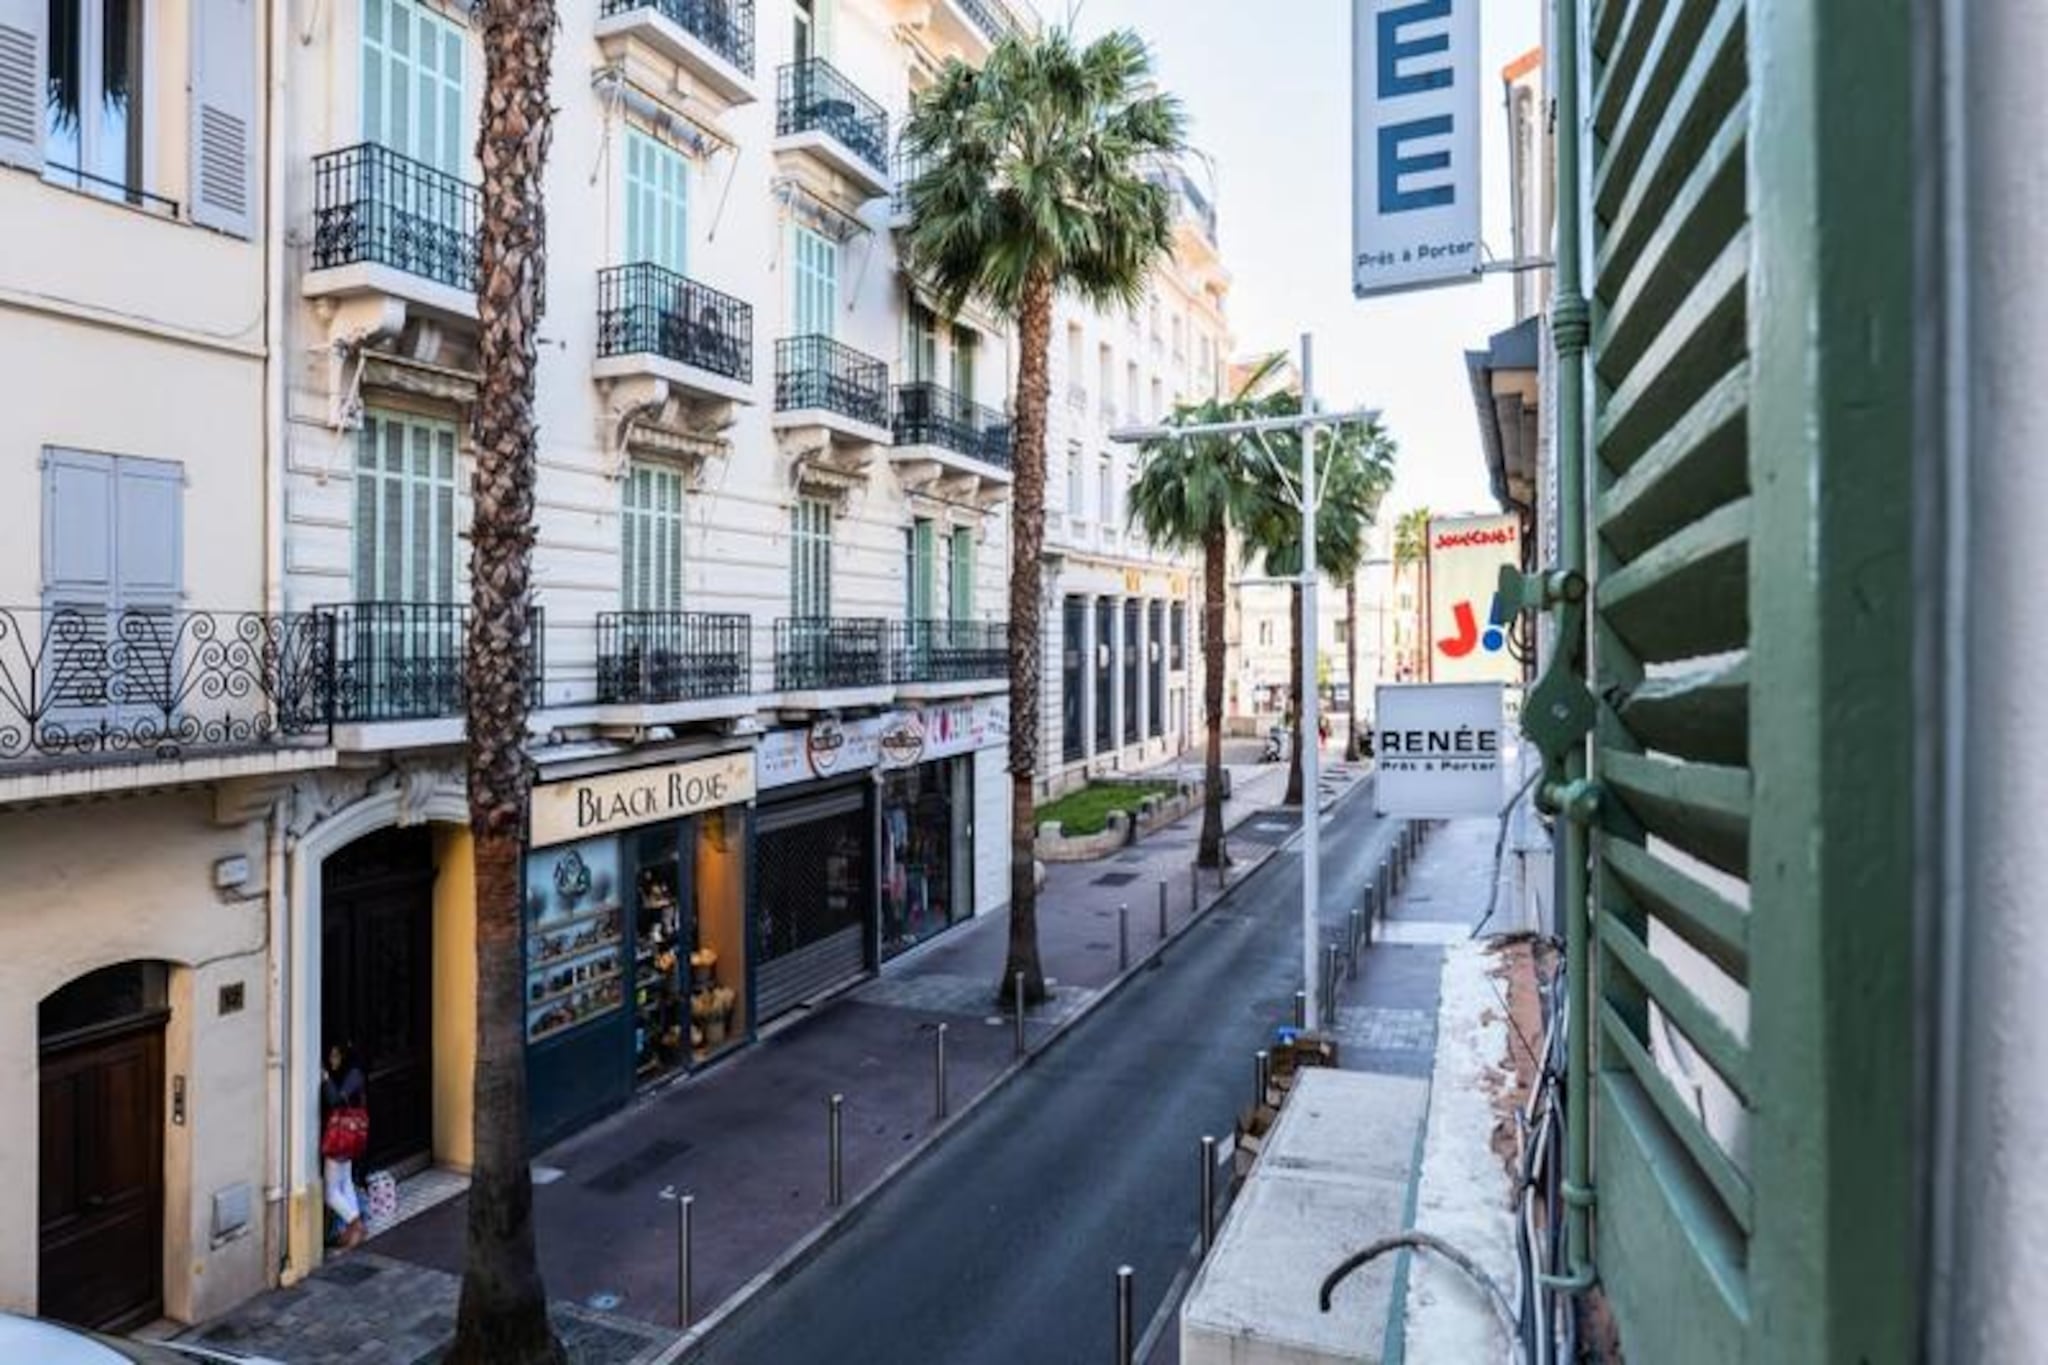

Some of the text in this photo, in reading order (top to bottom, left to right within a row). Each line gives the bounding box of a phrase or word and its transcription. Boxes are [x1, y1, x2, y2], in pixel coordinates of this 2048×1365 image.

[1418, 241, 1475, 259] Porter
[1381, 723, 1497, 751] RENÉE
[1441, 761, 1496, 771] Porter
